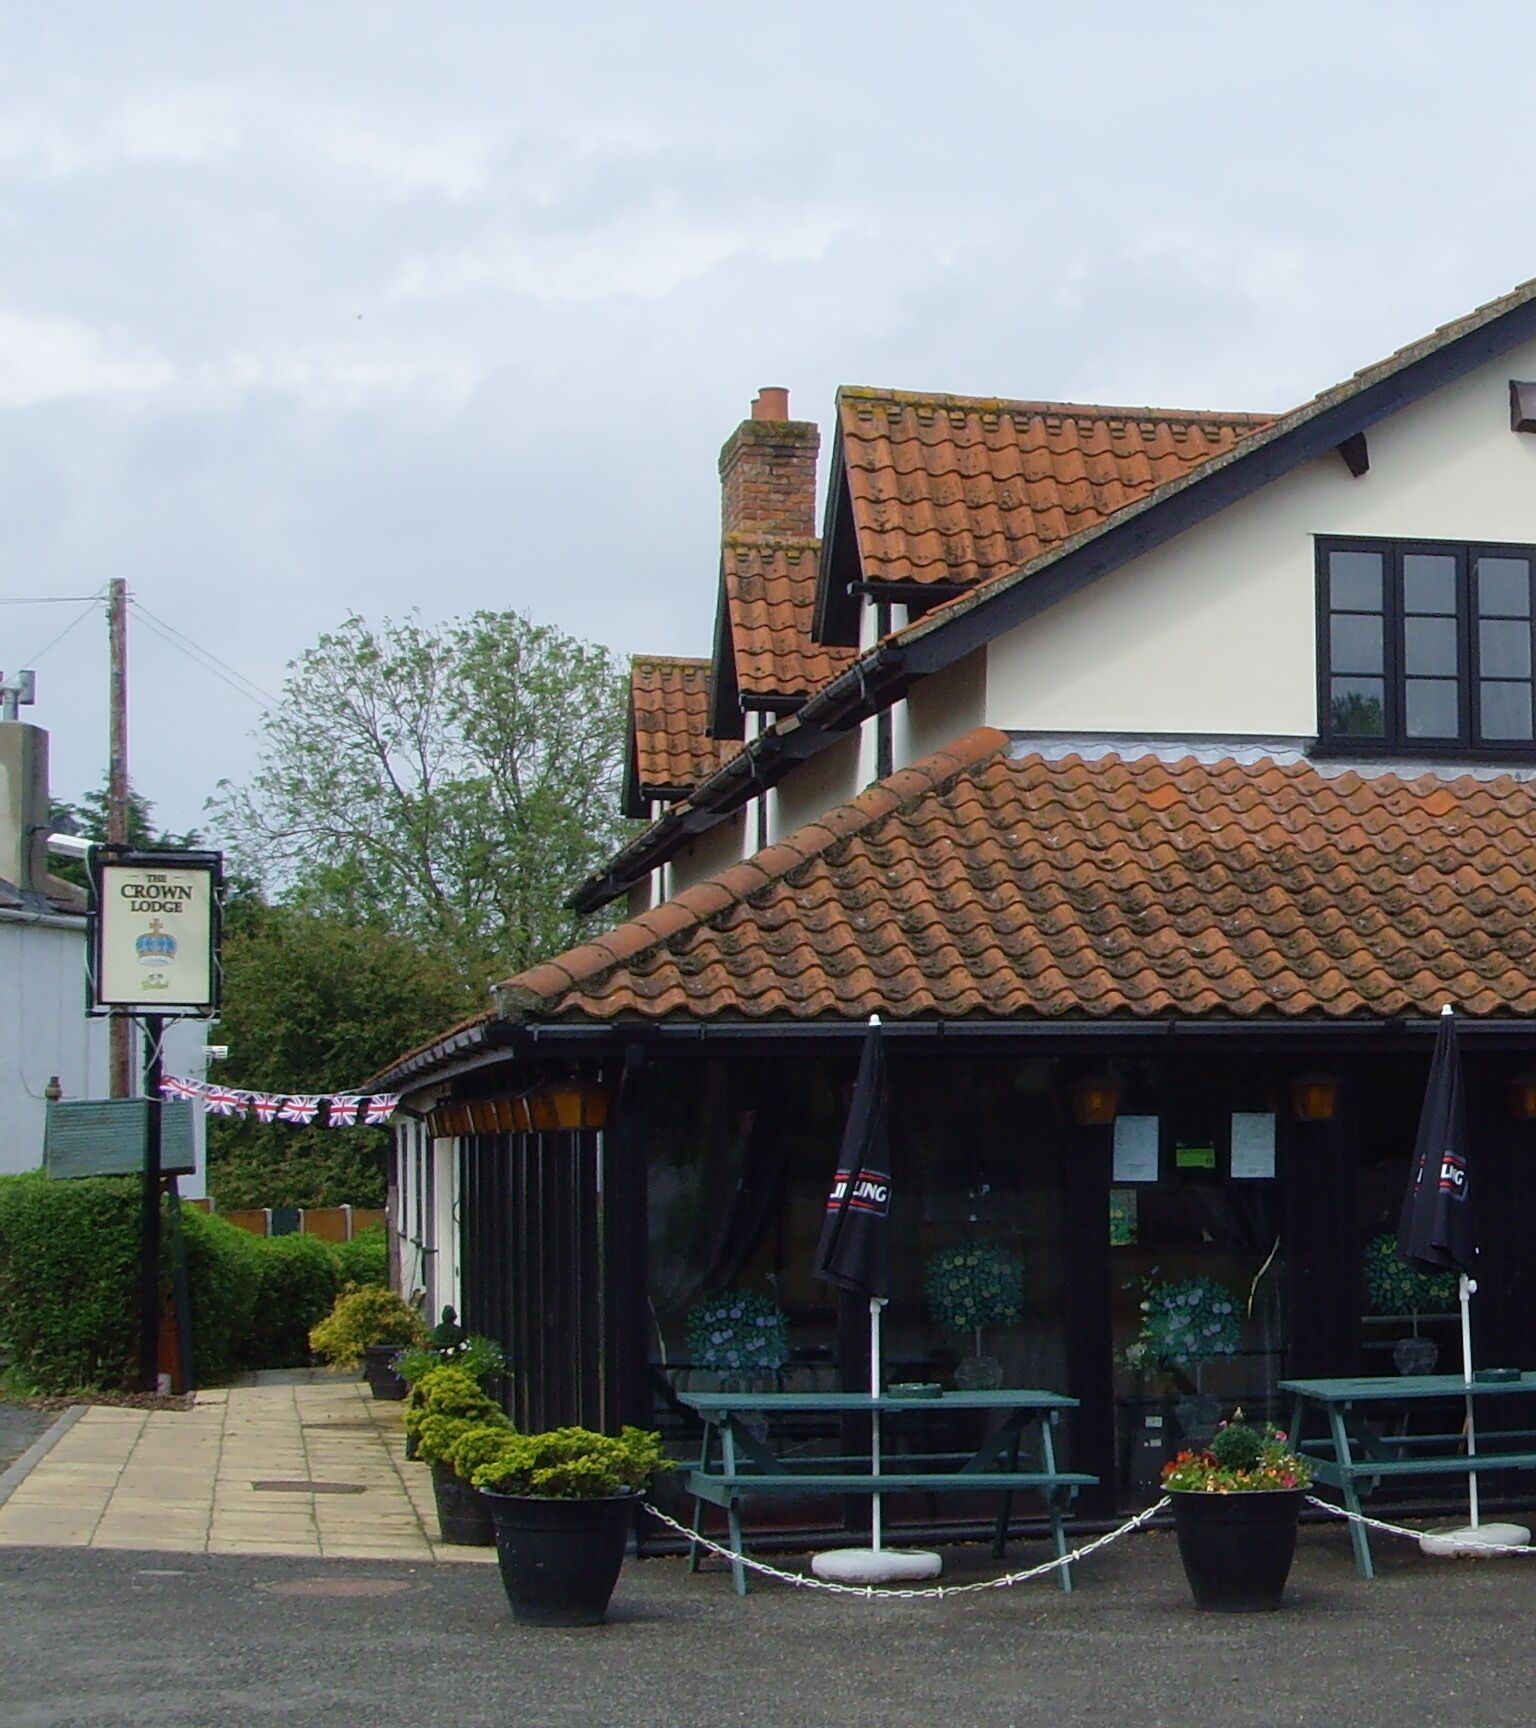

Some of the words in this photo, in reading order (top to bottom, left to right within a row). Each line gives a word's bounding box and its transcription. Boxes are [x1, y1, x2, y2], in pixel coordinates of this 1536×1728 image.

[146, 874, 167, 883] THE
[121, 884, 193, 899] CROWN
[131, 901, 183, 913] LODGE
